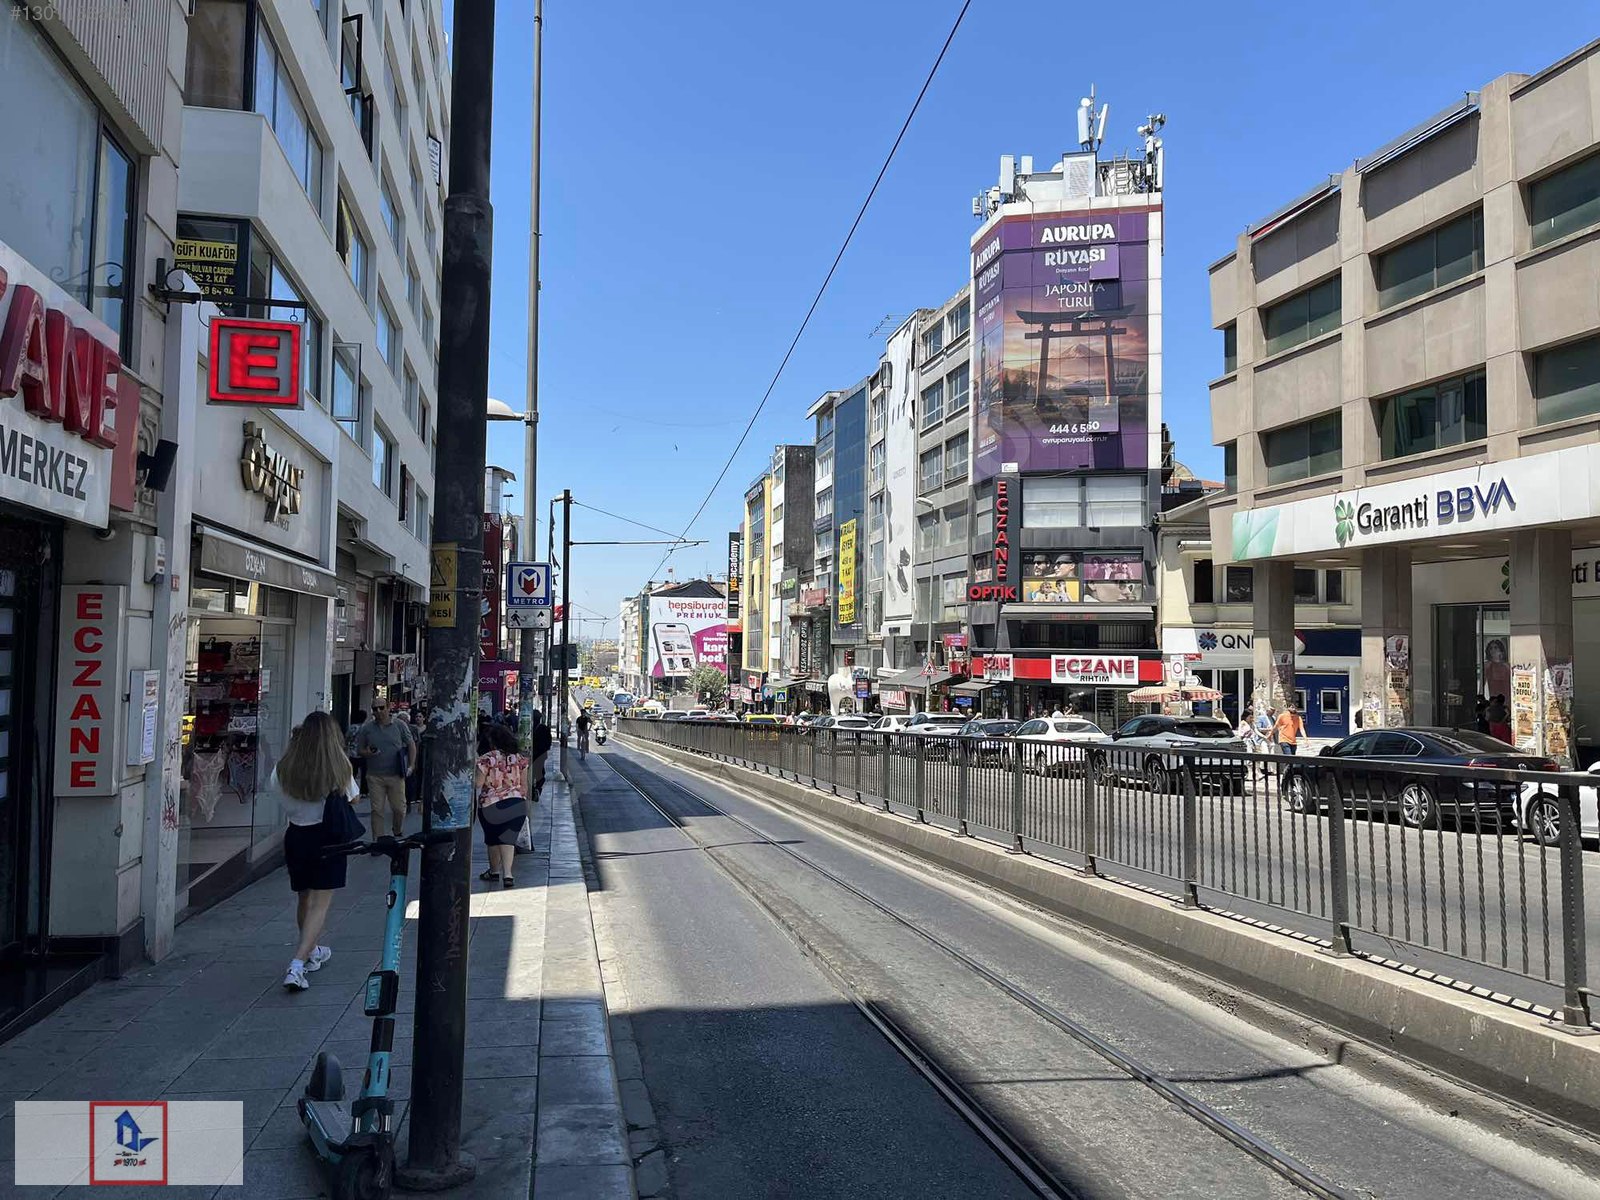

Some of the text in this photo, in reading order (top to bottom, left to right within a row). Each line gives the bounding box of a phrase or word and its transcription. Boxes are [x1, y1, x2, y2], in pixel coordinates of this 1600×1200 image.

[199, 245, 236, 260] KUAFÖR
[1045, 248, 1106, 266] RÜYASI
[214, 275, 227, 283] KAT
[1045, 282, 1106, 297] JAPONYA
[1058, 296, 1092, 308] TURU
[0, 270, 121, 450] ANE
[229, 333, 281, 391] E
[1049, 424, 1070, 434] 444
[1071, 424, 1078, 433] 6
[0, 424, 88, 501] MERKEZ
[1357, 477, 1515, 530] Garanti BBVA
[995, 481, 1009, 579] ECZANE
[969, 584, 1017, 600] OPTİK
[1055, 659, 1135, 673] ECZANE
[70, 593, 103, 788] ECZANE
